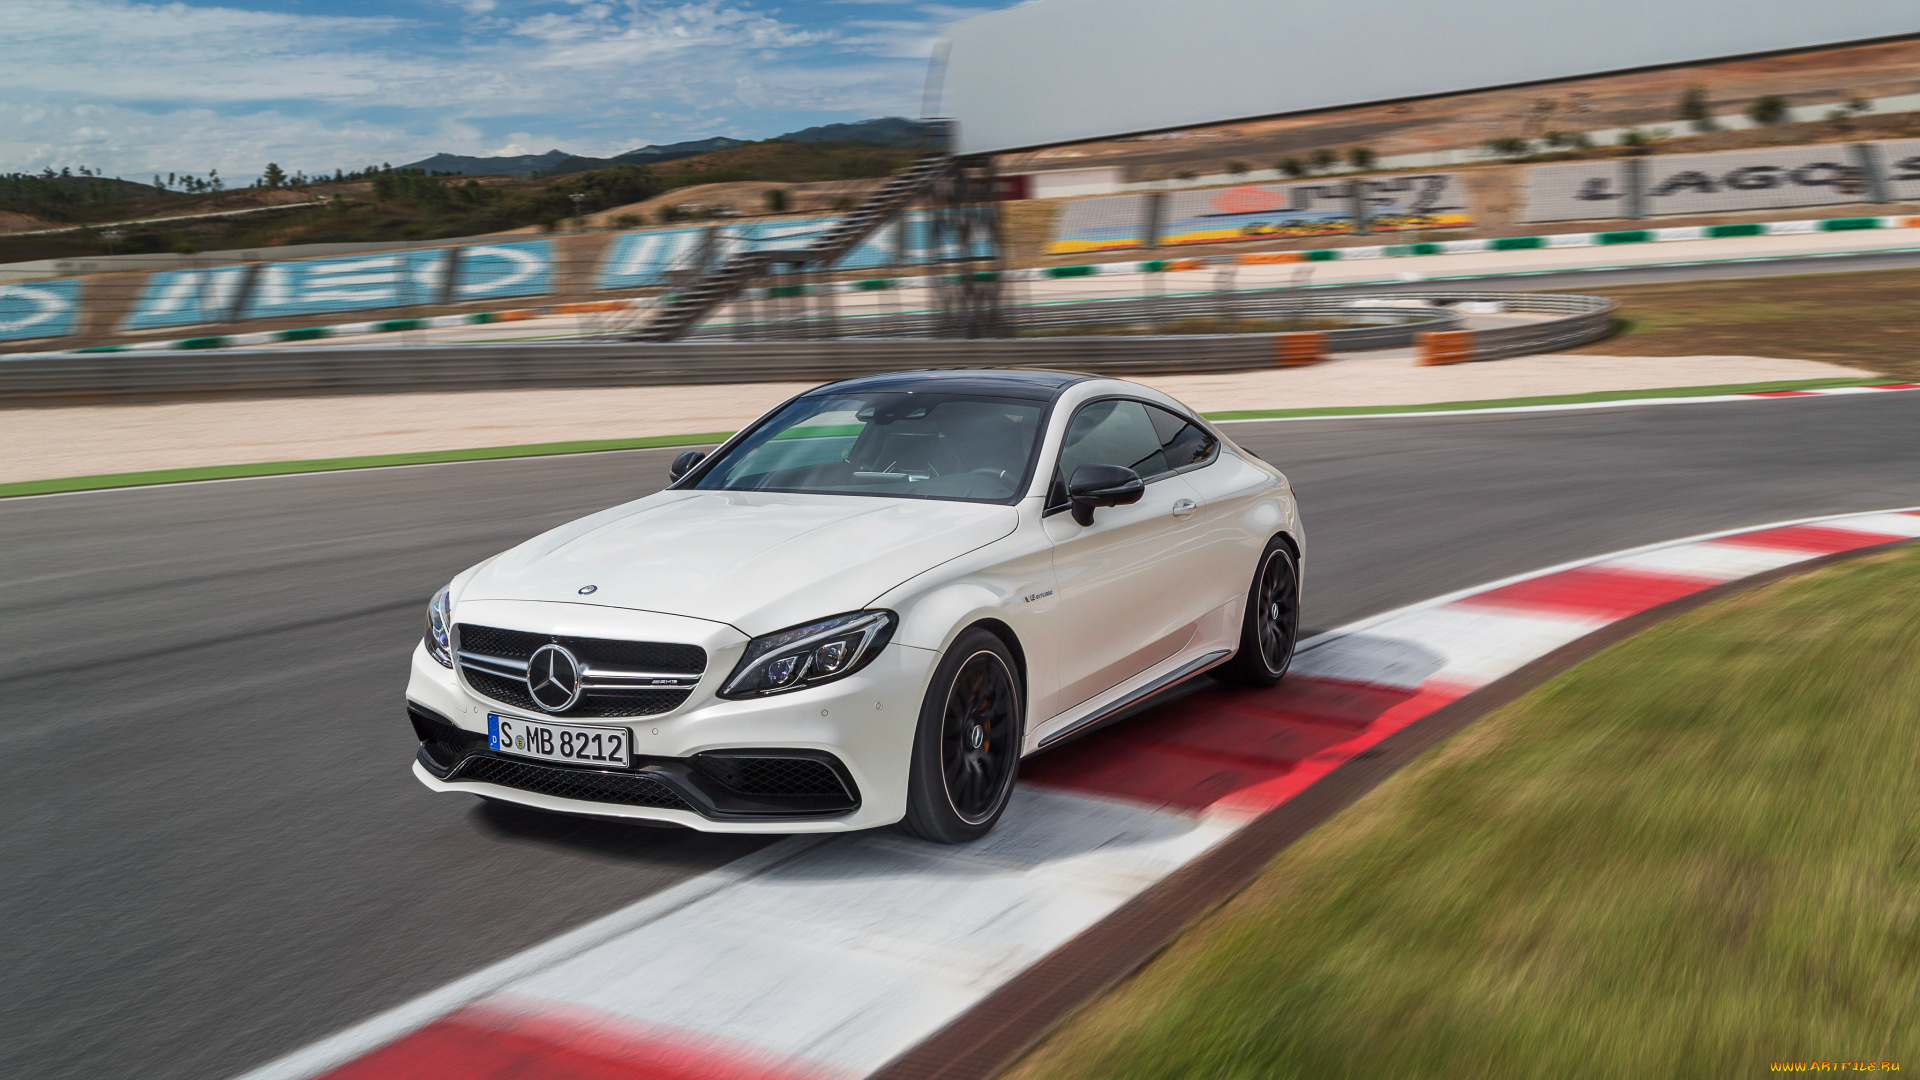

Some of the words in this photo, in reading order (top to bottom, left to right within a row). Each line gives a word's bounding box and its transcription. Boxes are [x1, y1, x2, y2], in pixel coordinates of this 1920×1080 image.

[501, 721, 513, 748] S
[525, 725, 555, 755] MB
[559, 730, 623, 763] 8212
